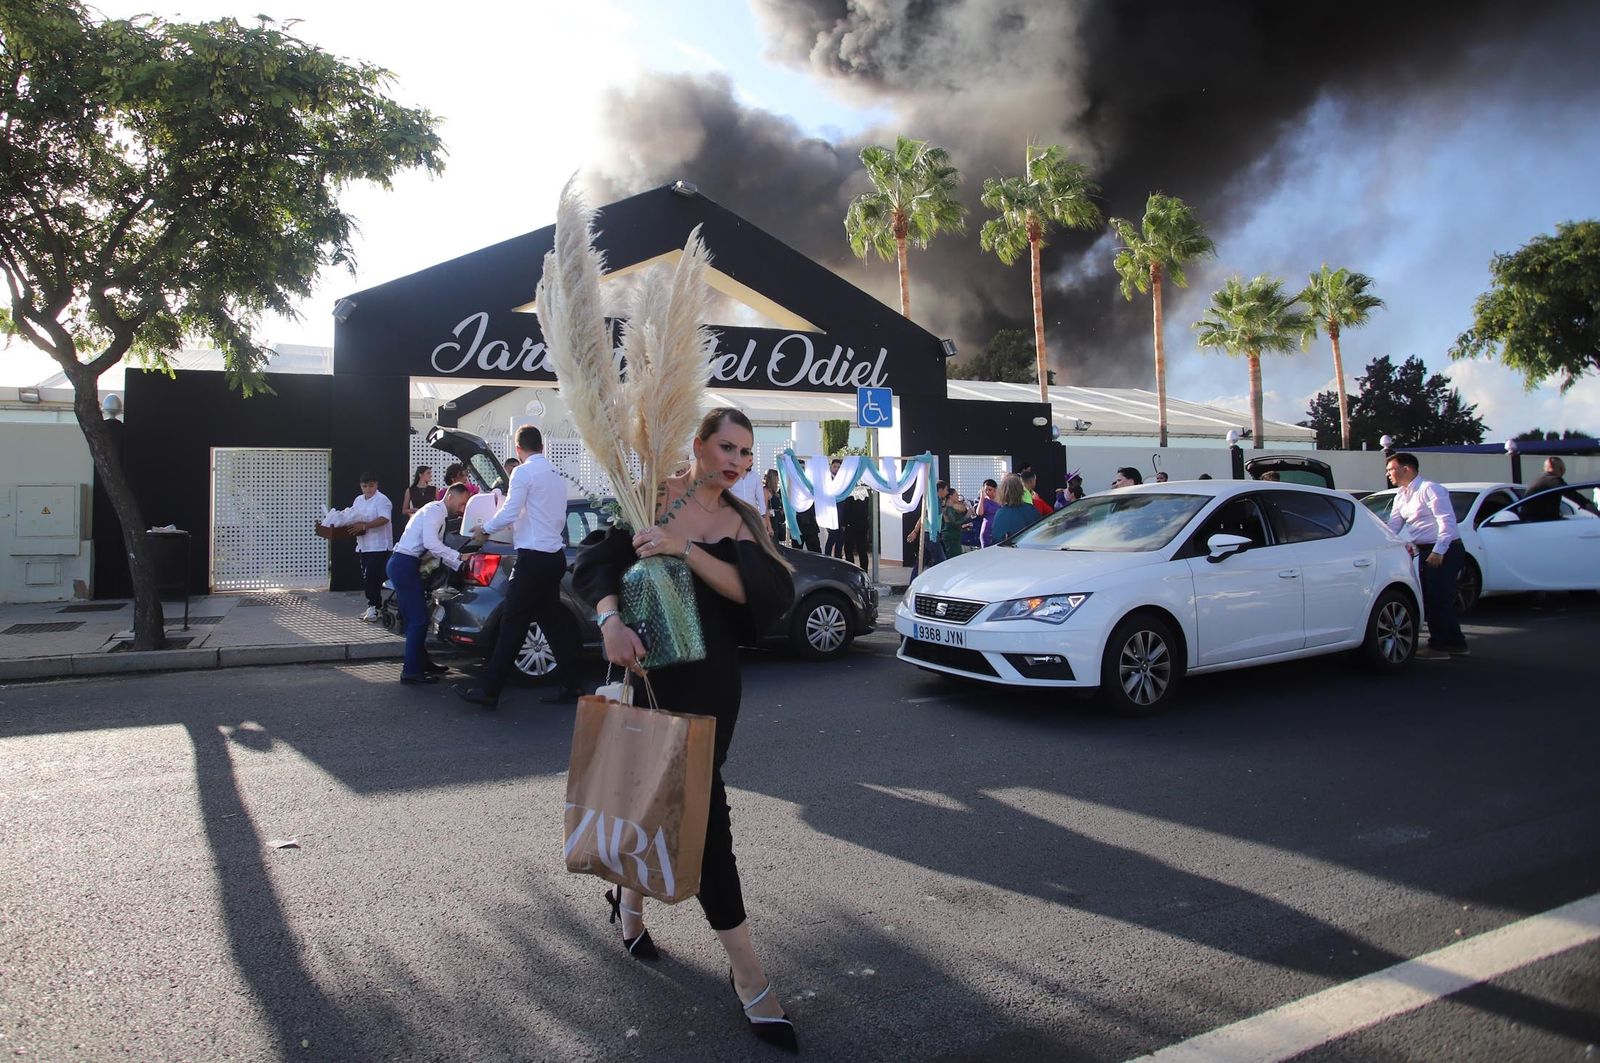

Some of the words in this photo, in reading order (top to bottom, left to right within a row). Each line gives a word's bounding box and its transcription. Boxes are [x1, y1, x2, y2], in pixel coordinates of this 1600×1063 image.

[767, 333, 889, 388] Odiel
[918, 625, 941, 642] 9368
[944, 630, 963, 645] JYN
[564, 802, 676, 897] ZARA
